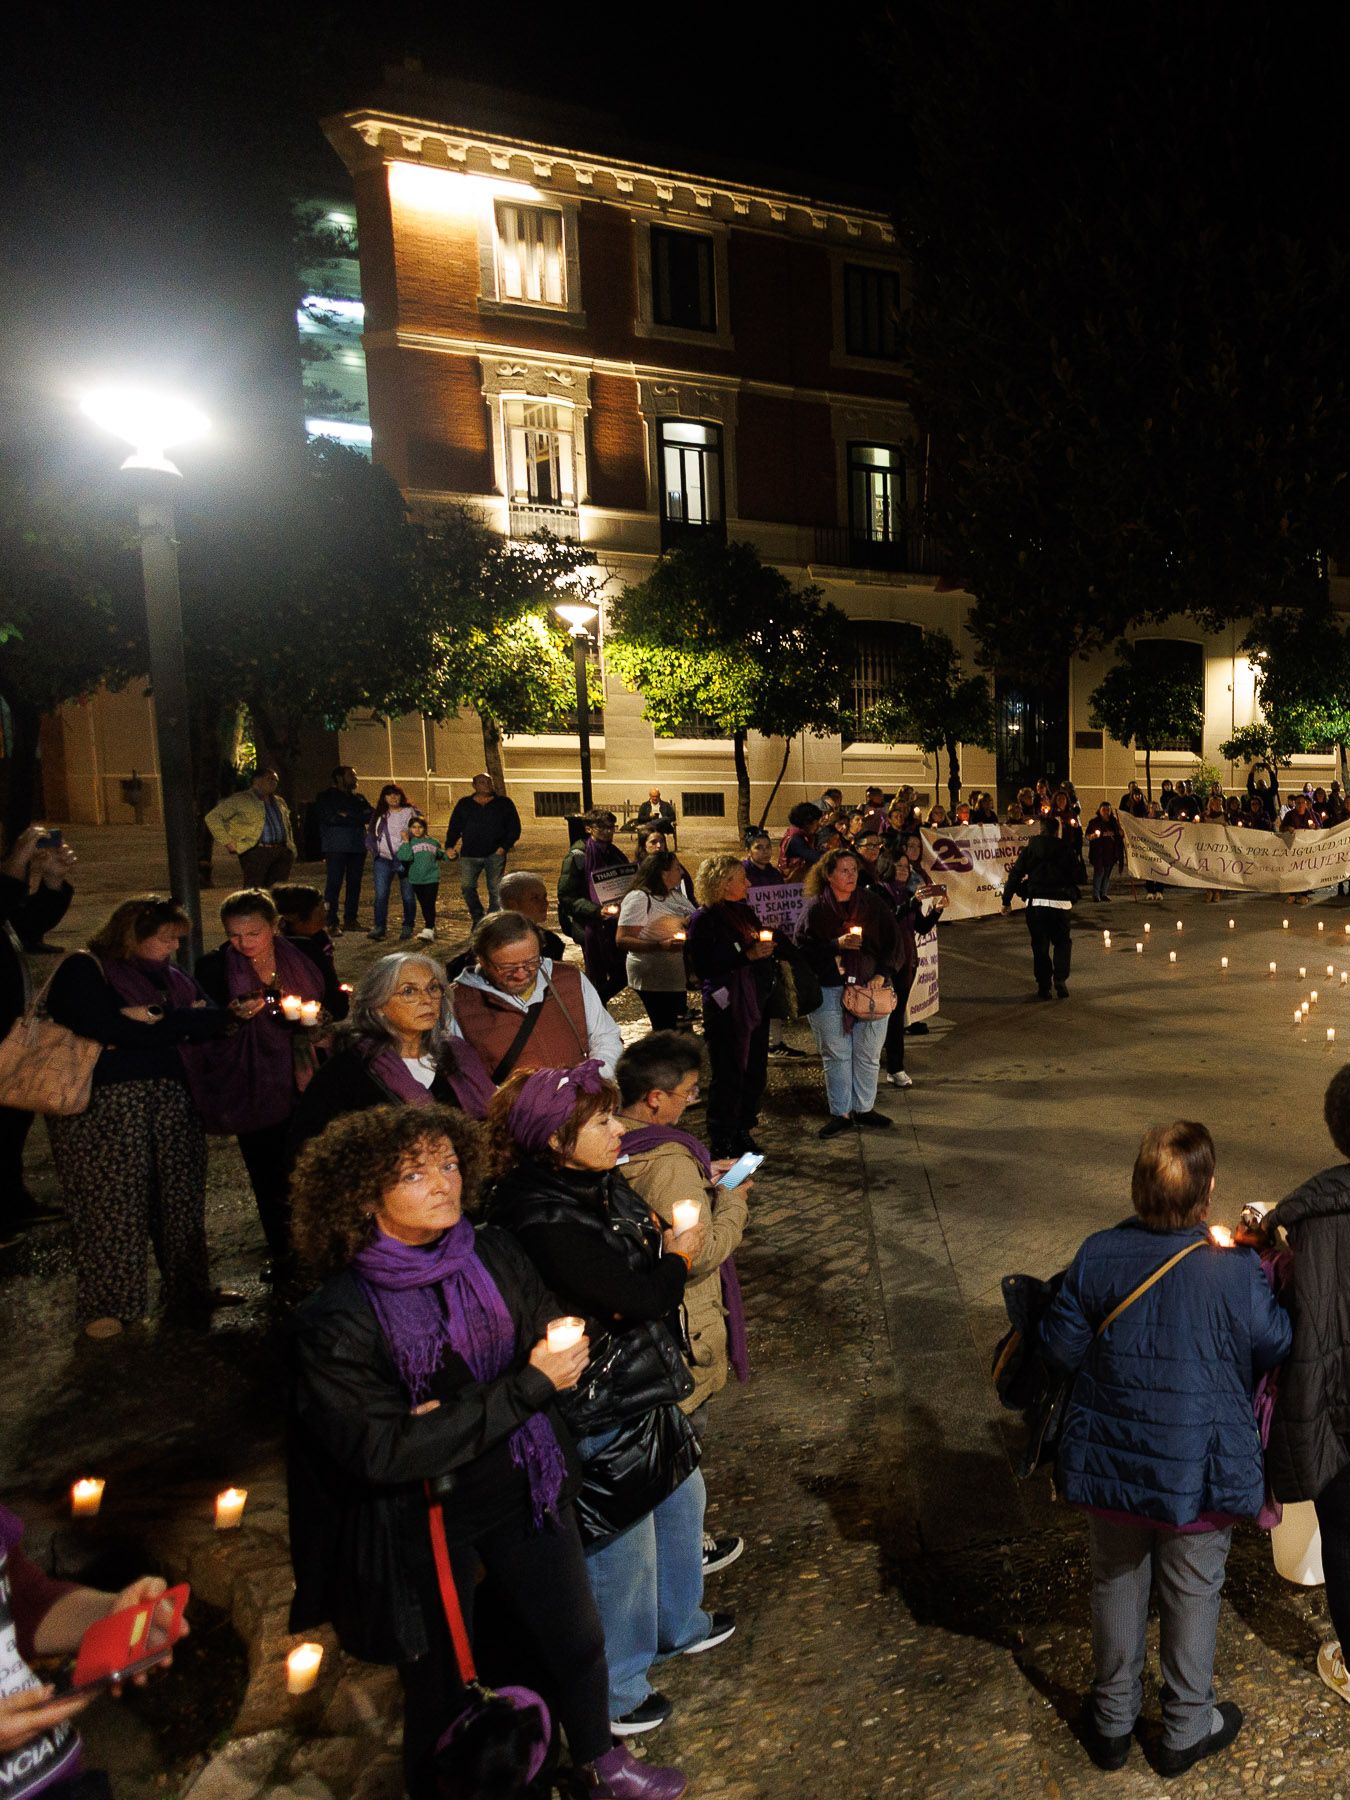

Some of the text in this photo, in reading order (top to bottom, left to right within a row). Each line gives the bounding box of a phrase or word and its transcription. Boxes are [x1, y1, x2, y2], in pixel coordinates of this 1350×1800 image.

[930, 838, 974, 873] 25
[1246, 847, 1269, 857] POR
[1219, 857, 1254, 875] VOZ
[755, 891, 770, 901] UN
